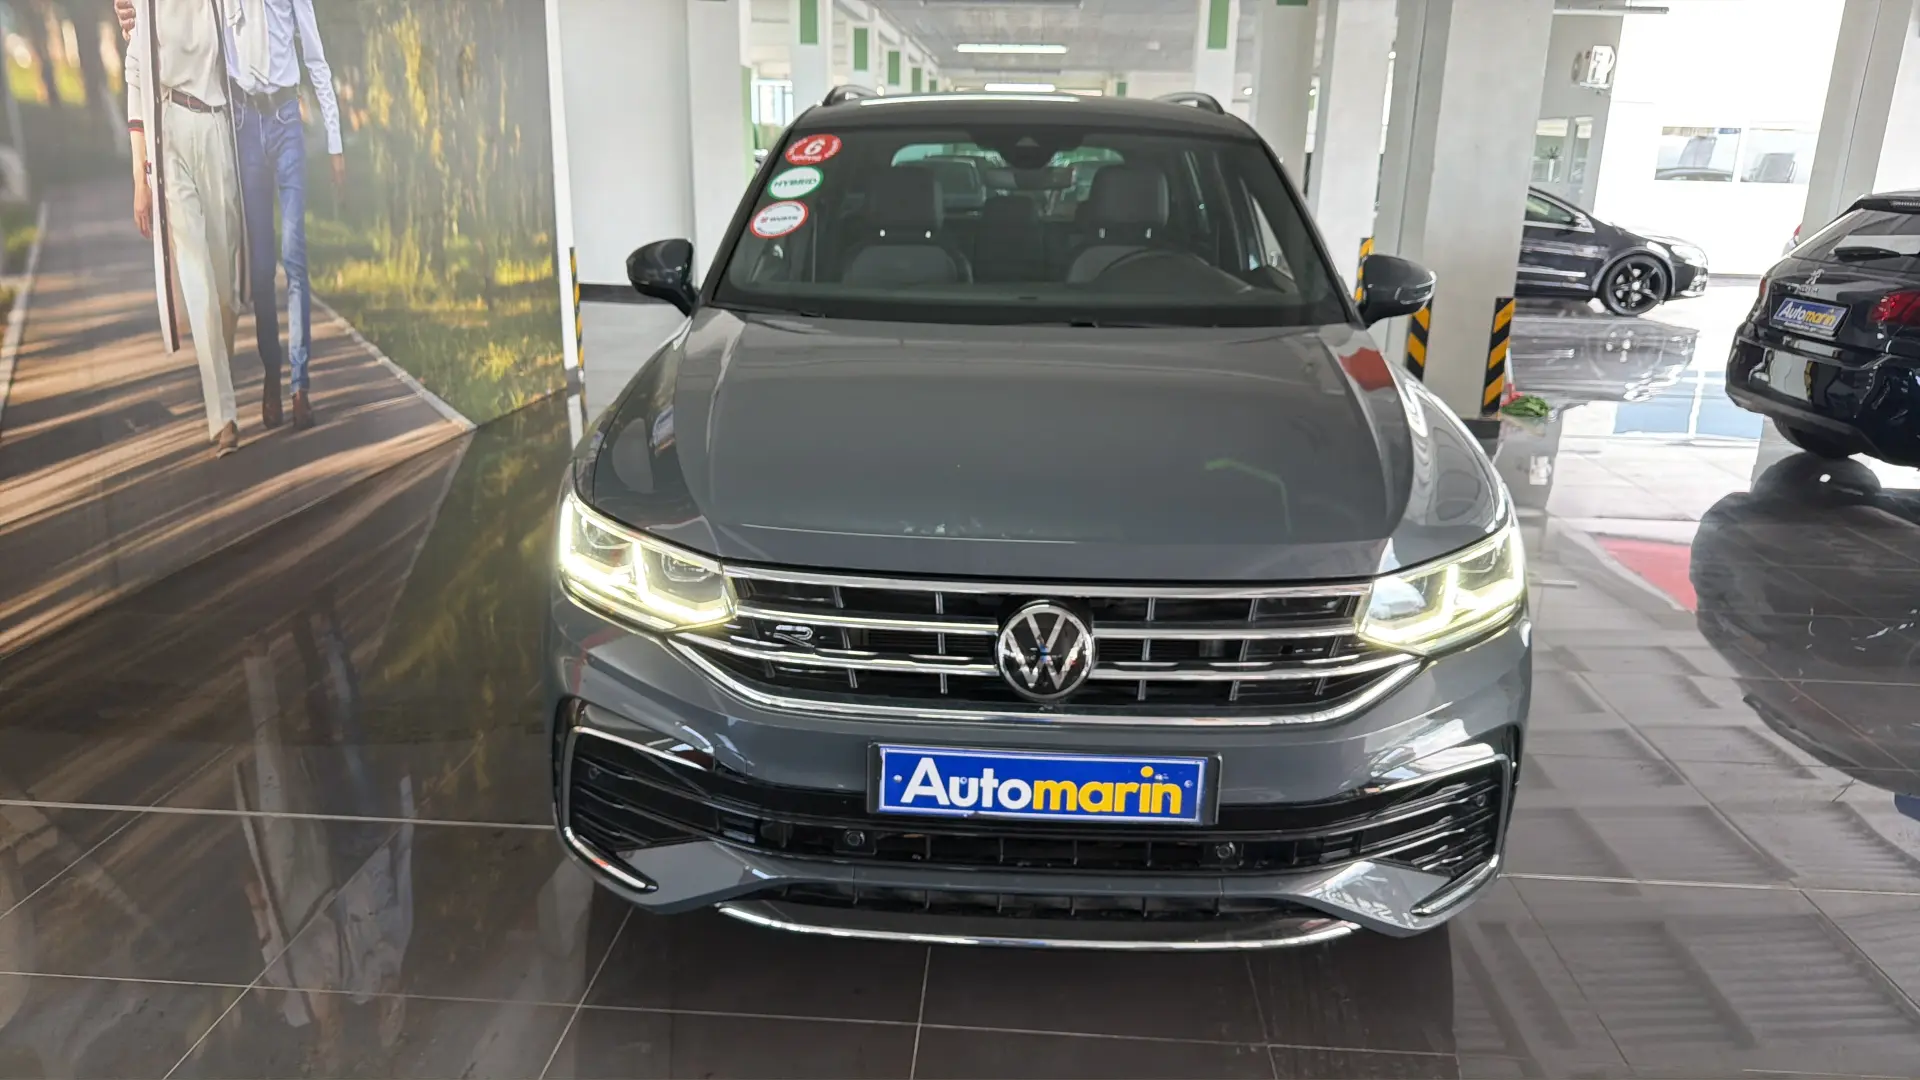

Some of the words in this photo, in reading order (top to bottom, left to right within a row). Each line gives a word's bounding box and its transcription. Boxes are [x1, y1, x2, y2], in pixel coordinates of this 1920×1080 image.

[804, 139, 826, 155] 6
[774, 178, 817, 187] HYBRID
[1779, 302, 1836, 326] Automarin
[900, 757, 1182, 814] Automarin
